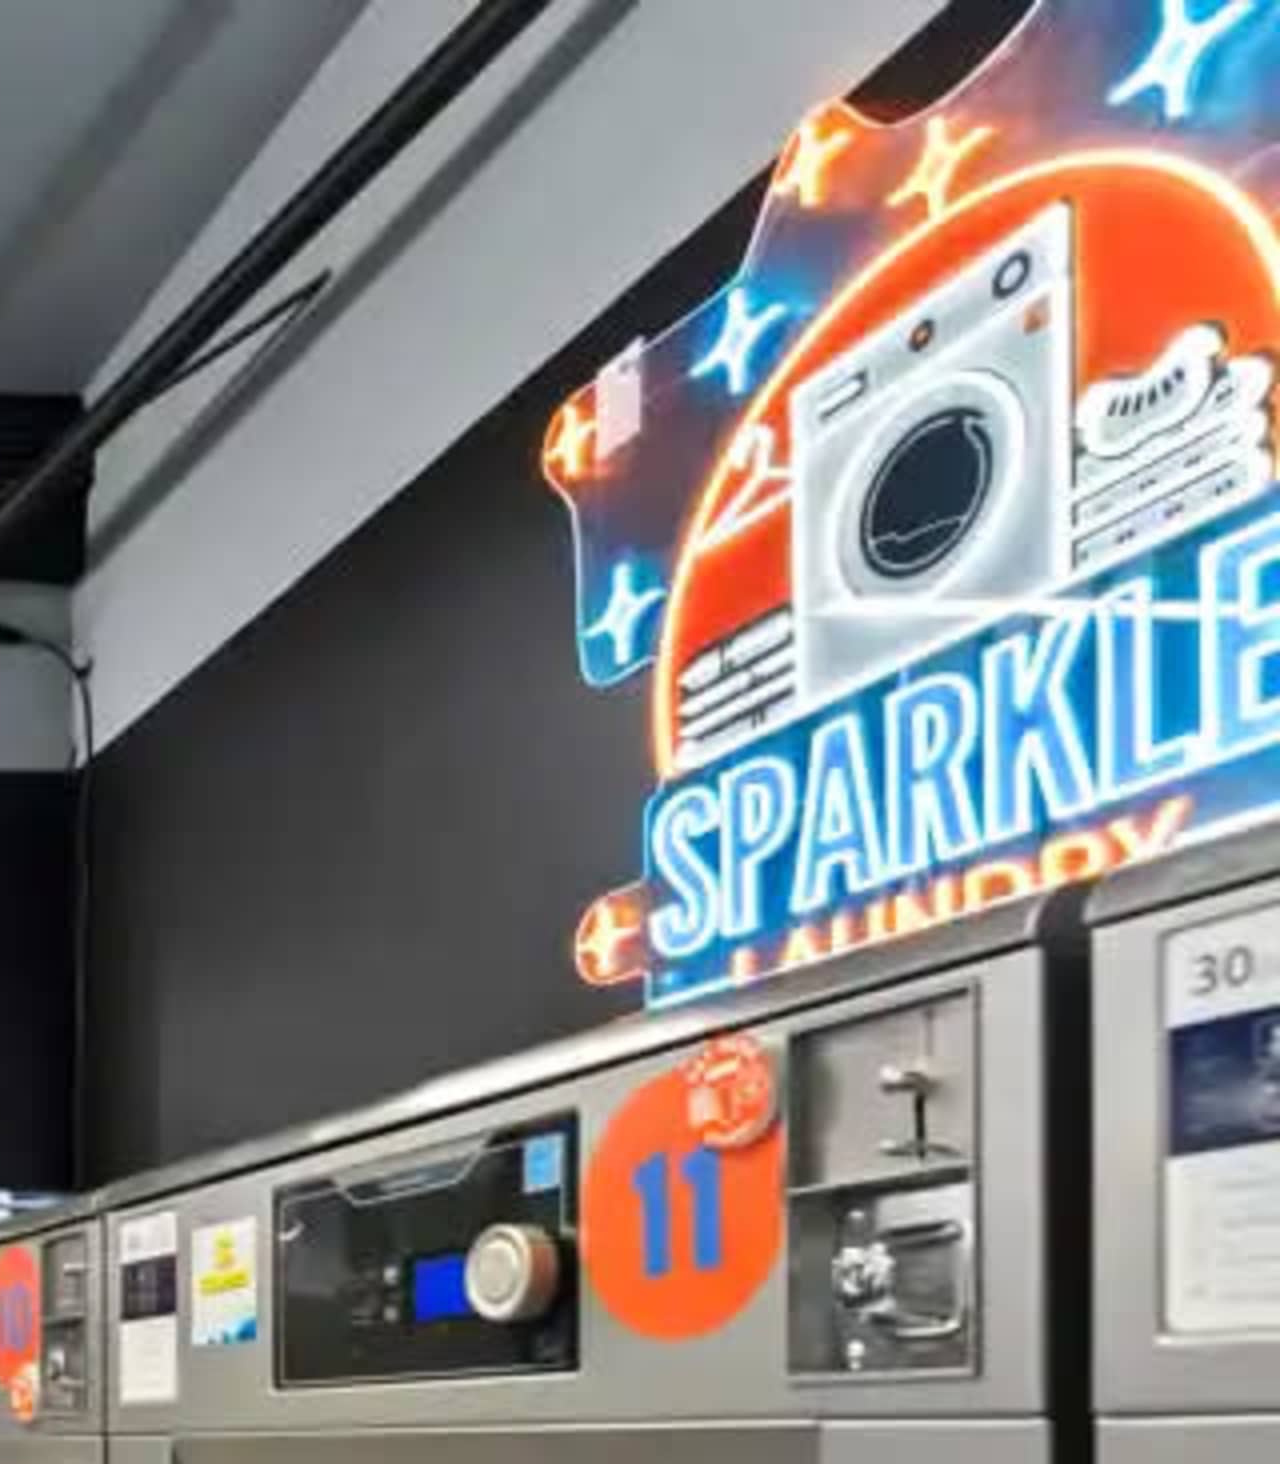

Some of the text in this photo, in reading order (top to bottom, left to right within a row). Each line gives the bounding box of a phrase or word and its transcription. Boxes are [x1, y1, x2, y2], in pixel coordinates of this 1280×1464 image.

[649, 511, 1280, 961] SPARKLE
[1188, 943, 1254, 997] 30
[632, 1144, 724, 1279] 11
